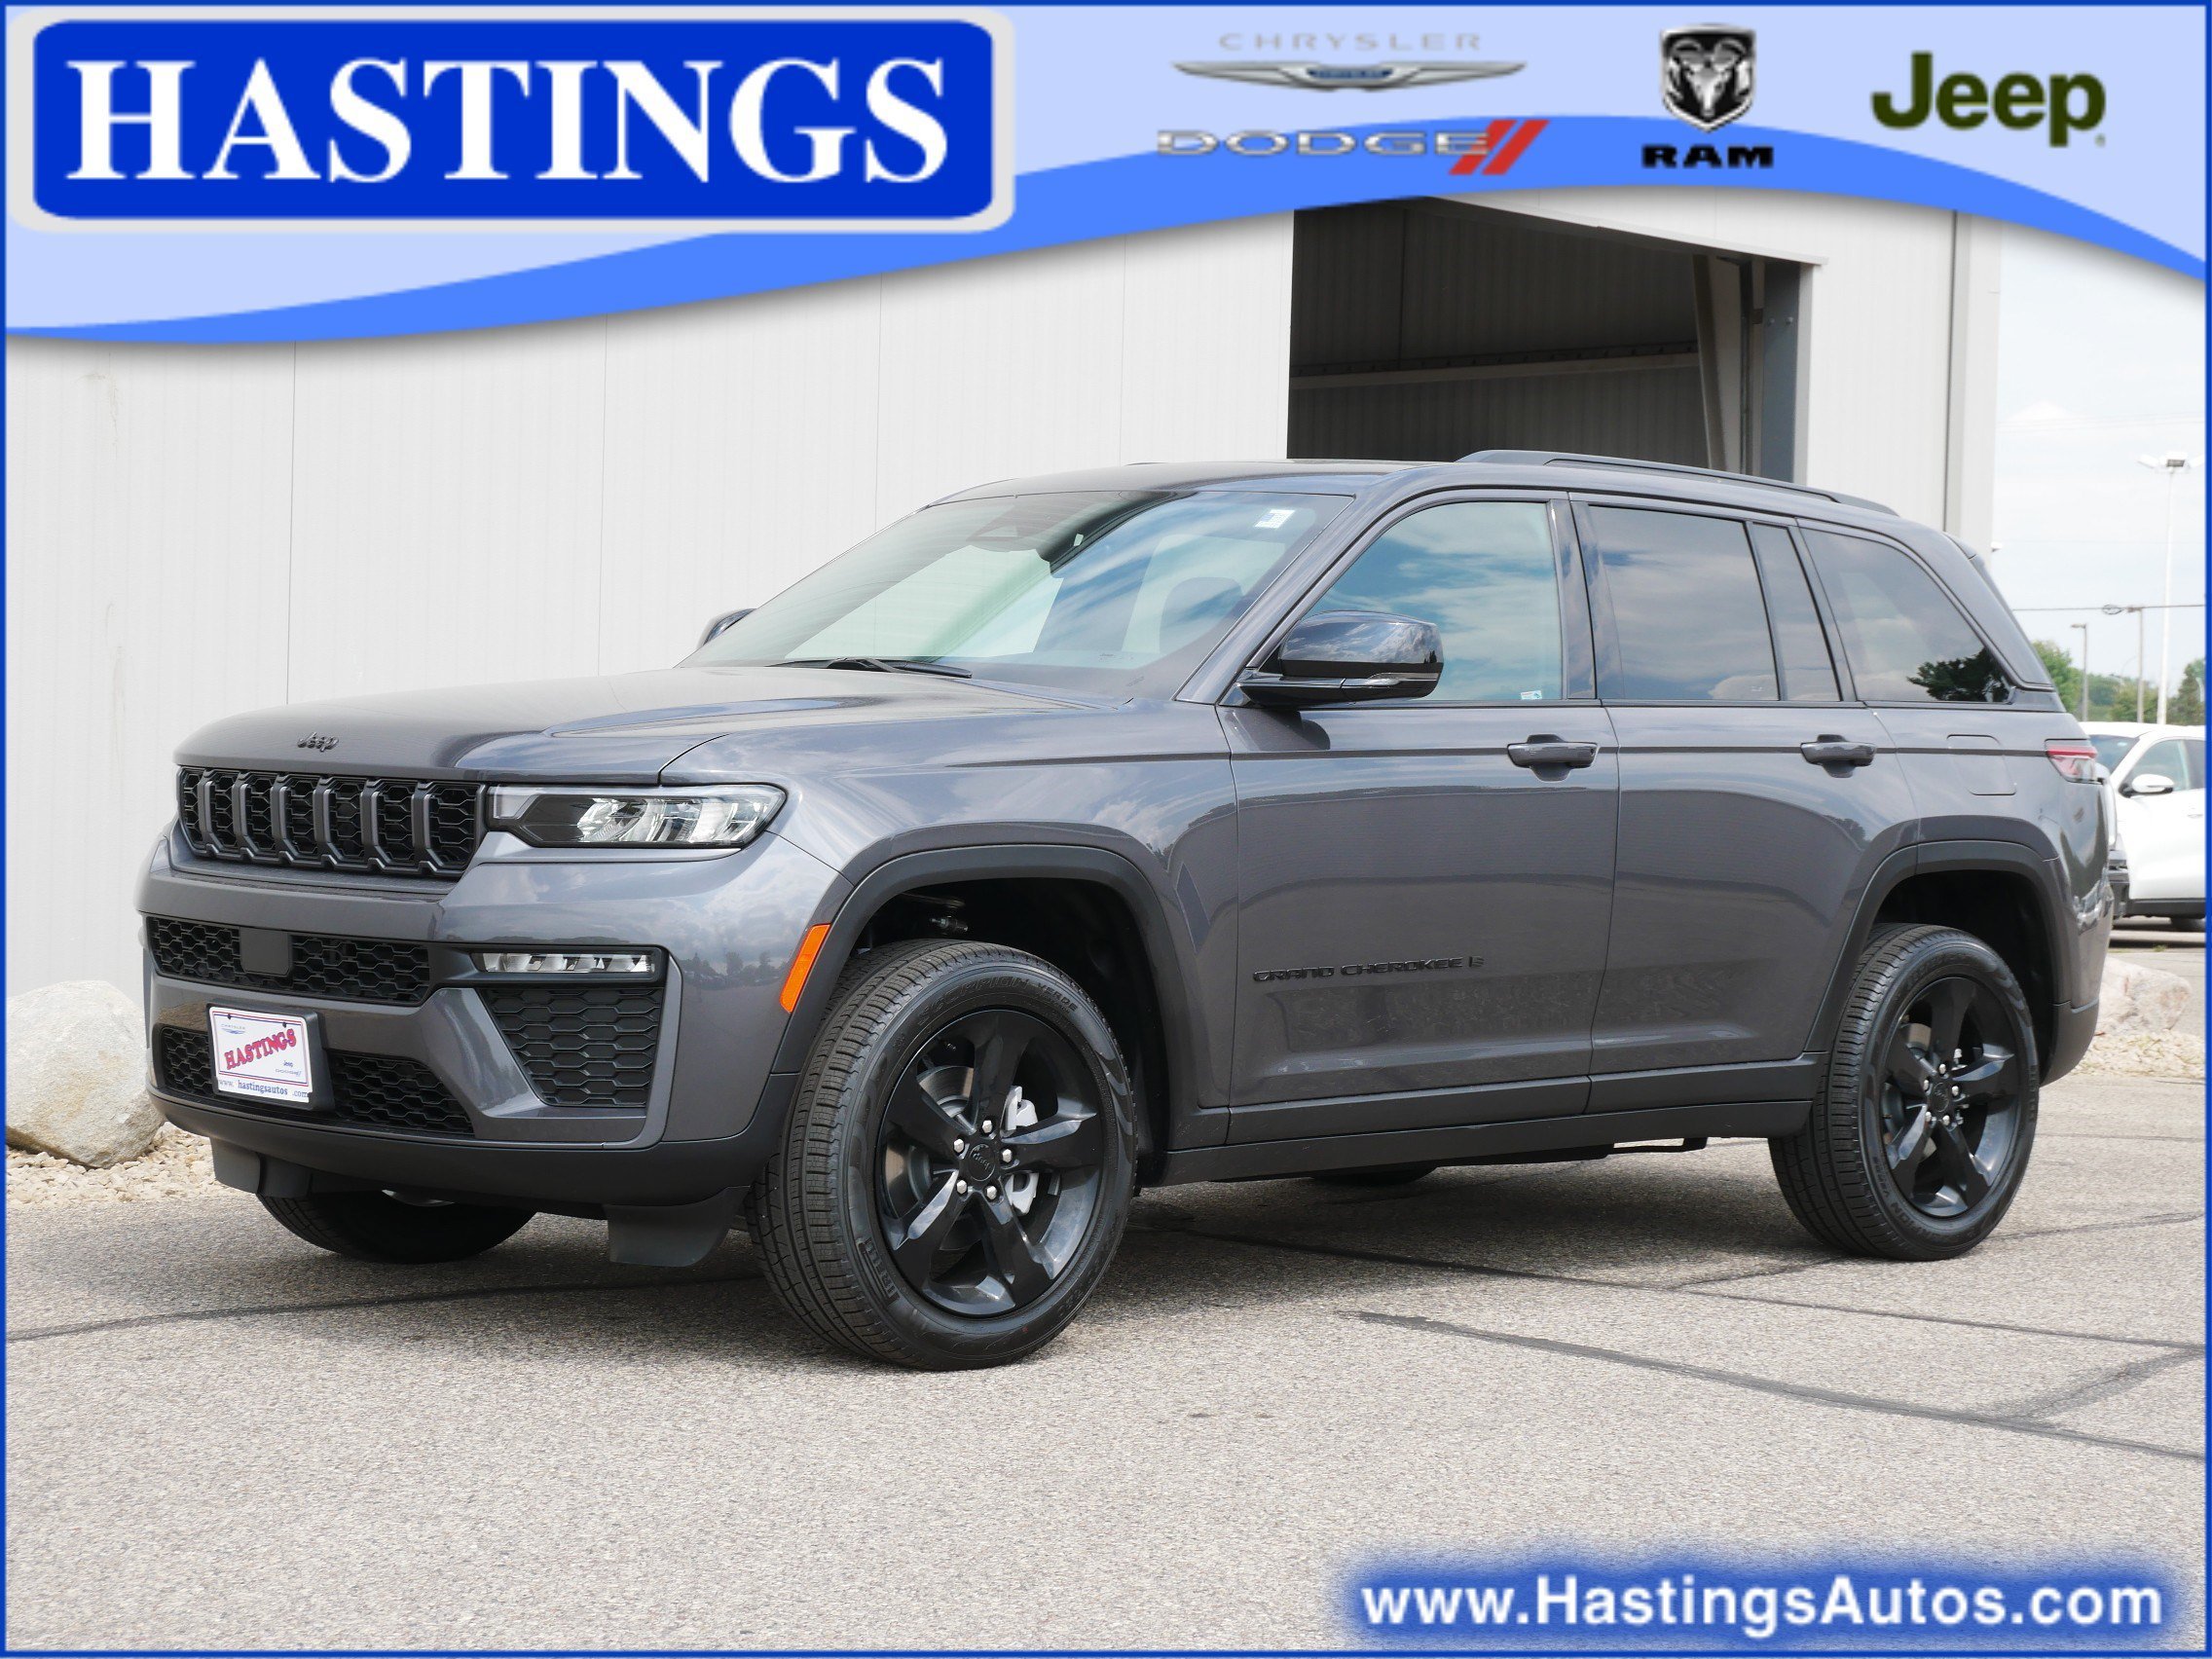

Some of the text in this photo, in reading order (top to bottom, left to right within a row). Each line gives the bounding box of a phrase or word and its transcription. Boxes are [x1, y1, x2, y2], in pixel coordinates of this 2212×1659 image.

[297, 731, 339, 753] Jeep
[1252, 957, 1463, 982] GRAND CHEROKEE
[225, 1028, 296, 1070] HASTINGS
